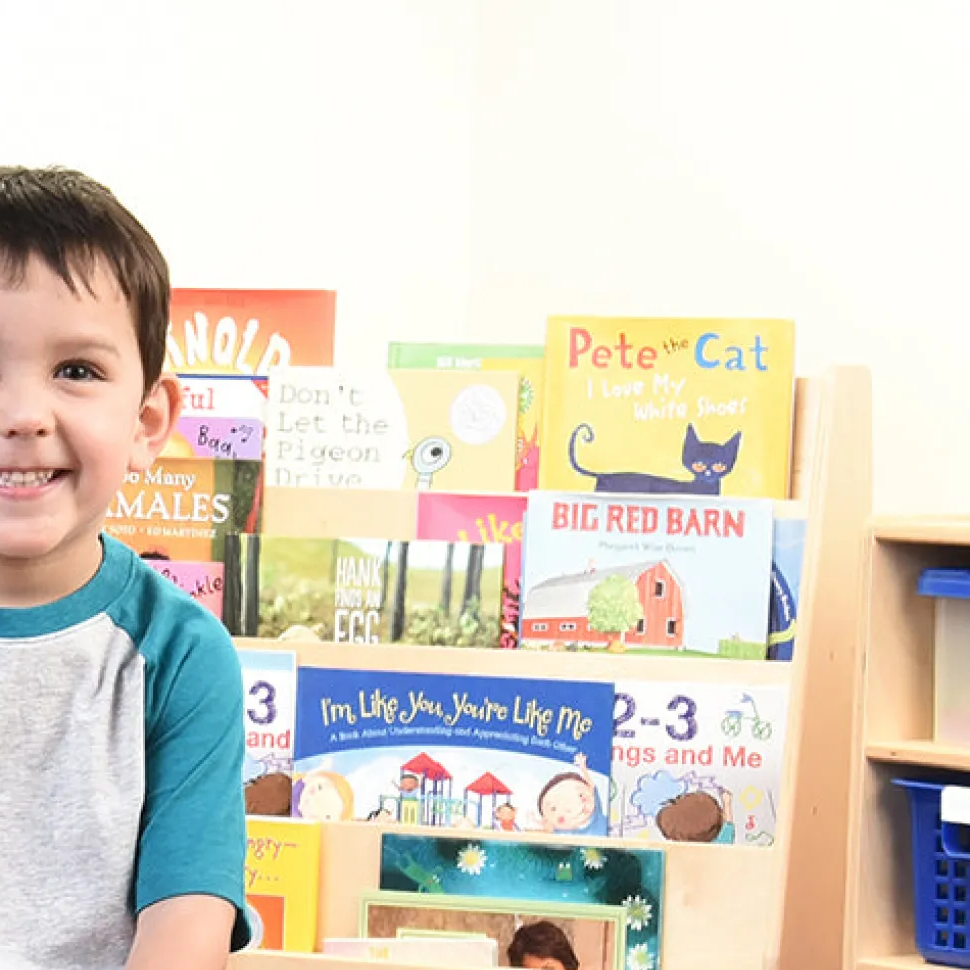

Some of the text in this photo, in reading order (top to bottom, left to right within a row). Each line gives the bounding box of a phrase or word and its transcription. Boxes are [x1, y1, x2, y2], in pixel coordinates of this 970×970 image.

[570, 327, 769, 371] Pete the Cat
[279, 384, 364, 407] Don't
[602, 377, 645, 398] Love
[654, 373, 686, 397] My
[634, 397, 688, 421] White
[277, 411, 389, 434] Let the
[277, 438, 381, 466] Pigeon
[145, 467, 196, 492] Many
[552, 502, 746, 538] BIG RED BARN
[336, 556, 382, 587] HANK
[359, 688, 398, 724] Like
[513, 695, 553, 737] Like
[556, 706, 592, 741] Me
[614, 692, 698, 742] 2-3
[247, 728, 290, 750] and
[664, 744, 713, 766] and
[723, 745, 763, 768] Me
